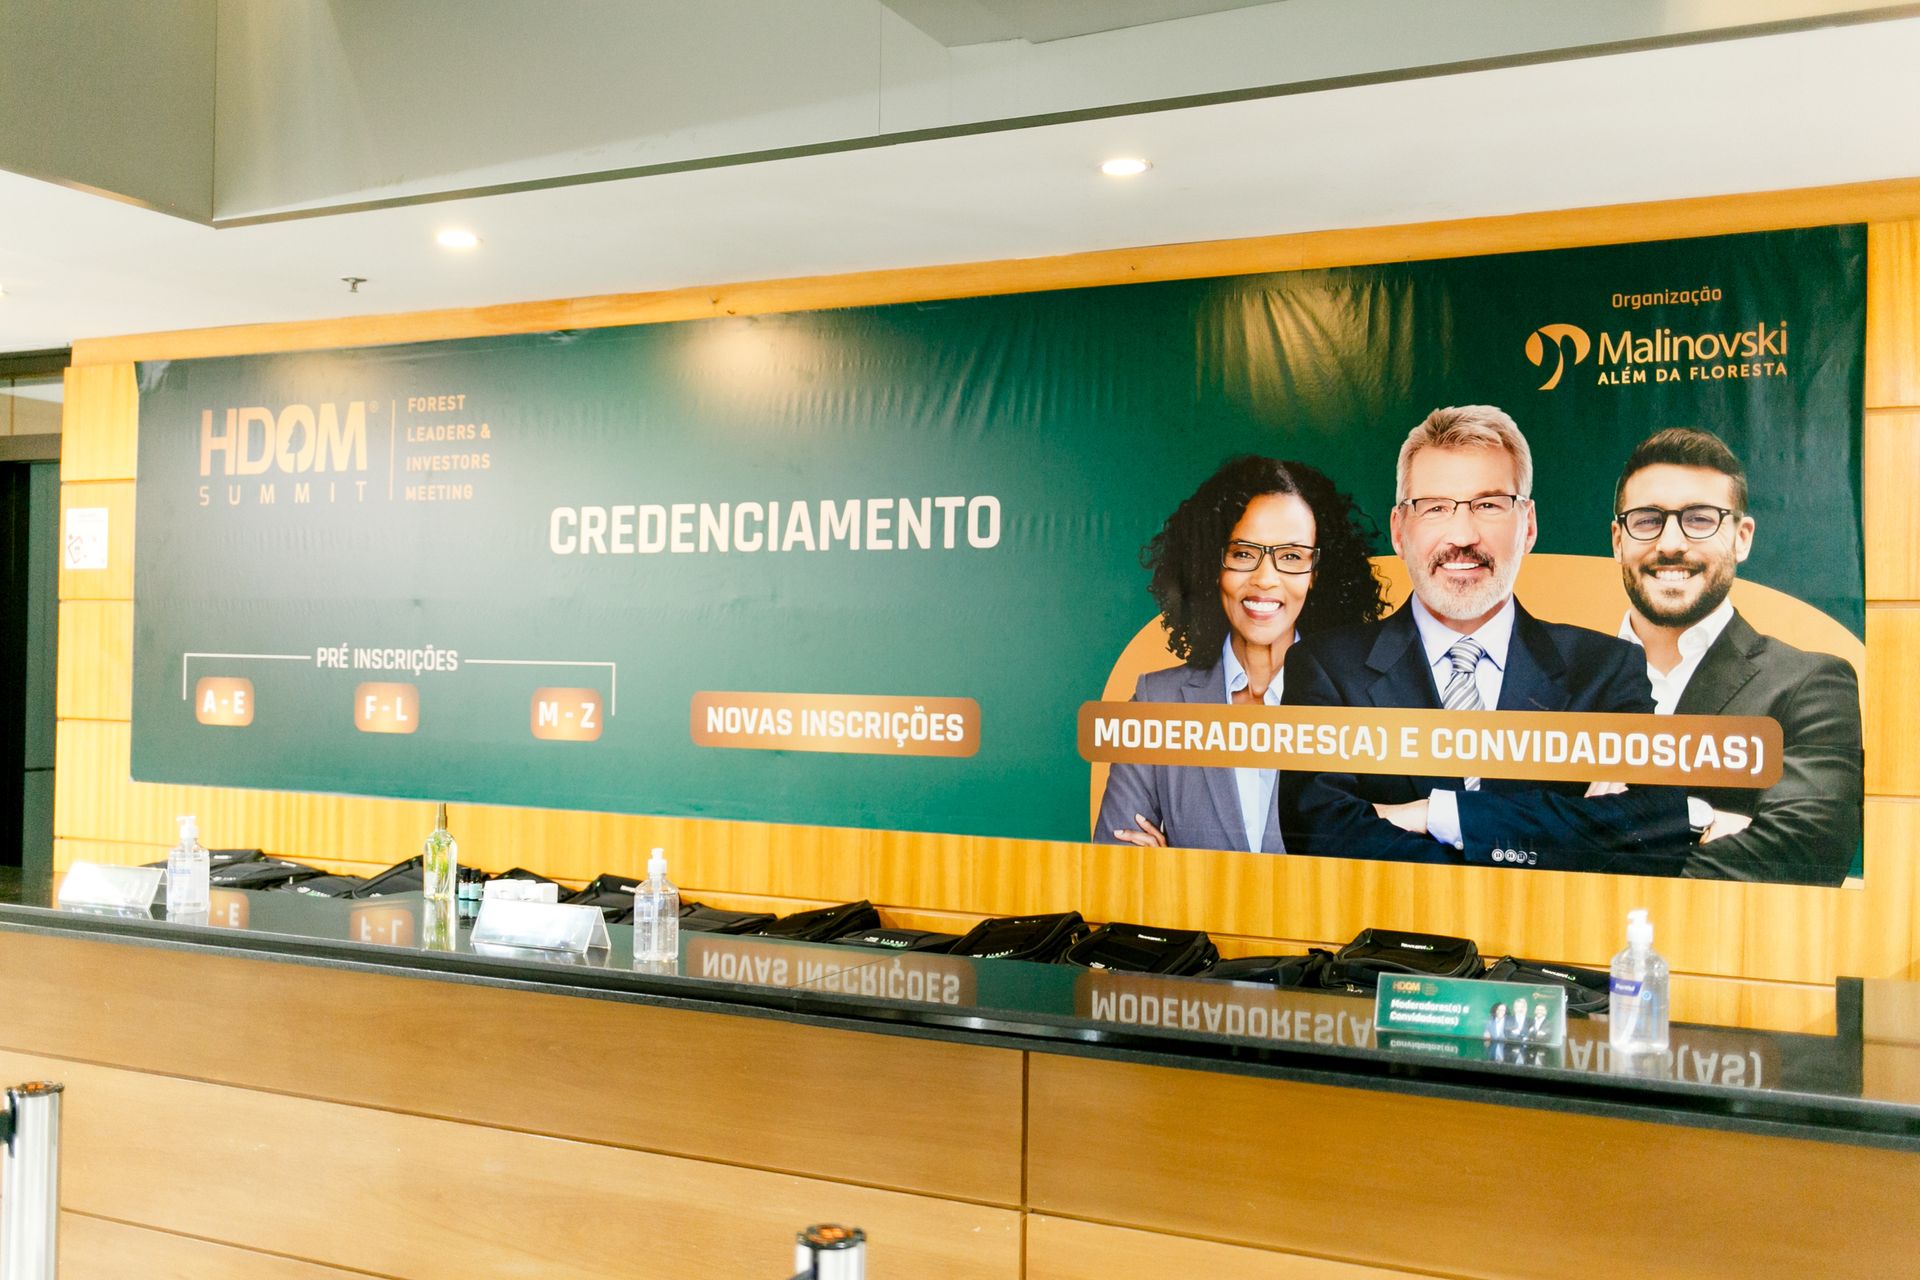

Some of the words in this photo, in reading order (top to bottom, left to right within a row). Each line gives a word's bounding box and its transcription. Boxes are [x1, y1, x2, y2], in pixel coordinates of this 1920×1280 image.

[1612, 286, 1722, 310] Organização
[1598, 320, 1787, 365] Malinovski
[1597, 366, 1647, 385] ALÉM
[1656, 367, 1681, 382] DA
[1690, 362, 1787, 380] FLORESTA
[407, 394, 466, 413] FOREST
[407, 424, 476, 443] LEADERS
[479, 423, 491, 440] &
[406, 453, 491, 472] INVESTORS
[405, 483, 473, 501] MEETING
[549, 495, 1001, 555] CREDENCIAMENTO
[317, 642, 349, 669] PRÉ
[354, 644, 458, 676] INSCRIÇÕES
[706, 706, 793, 737] NOVAS
[801, 706, 964, 748] INSCRIÇÕES
[1094, 717, 1388, 761] MODERADORES(A)
[1400, 727, 1419, 758] E
[1431, 727, 1764, 774] CONVIDADOS(AS)
